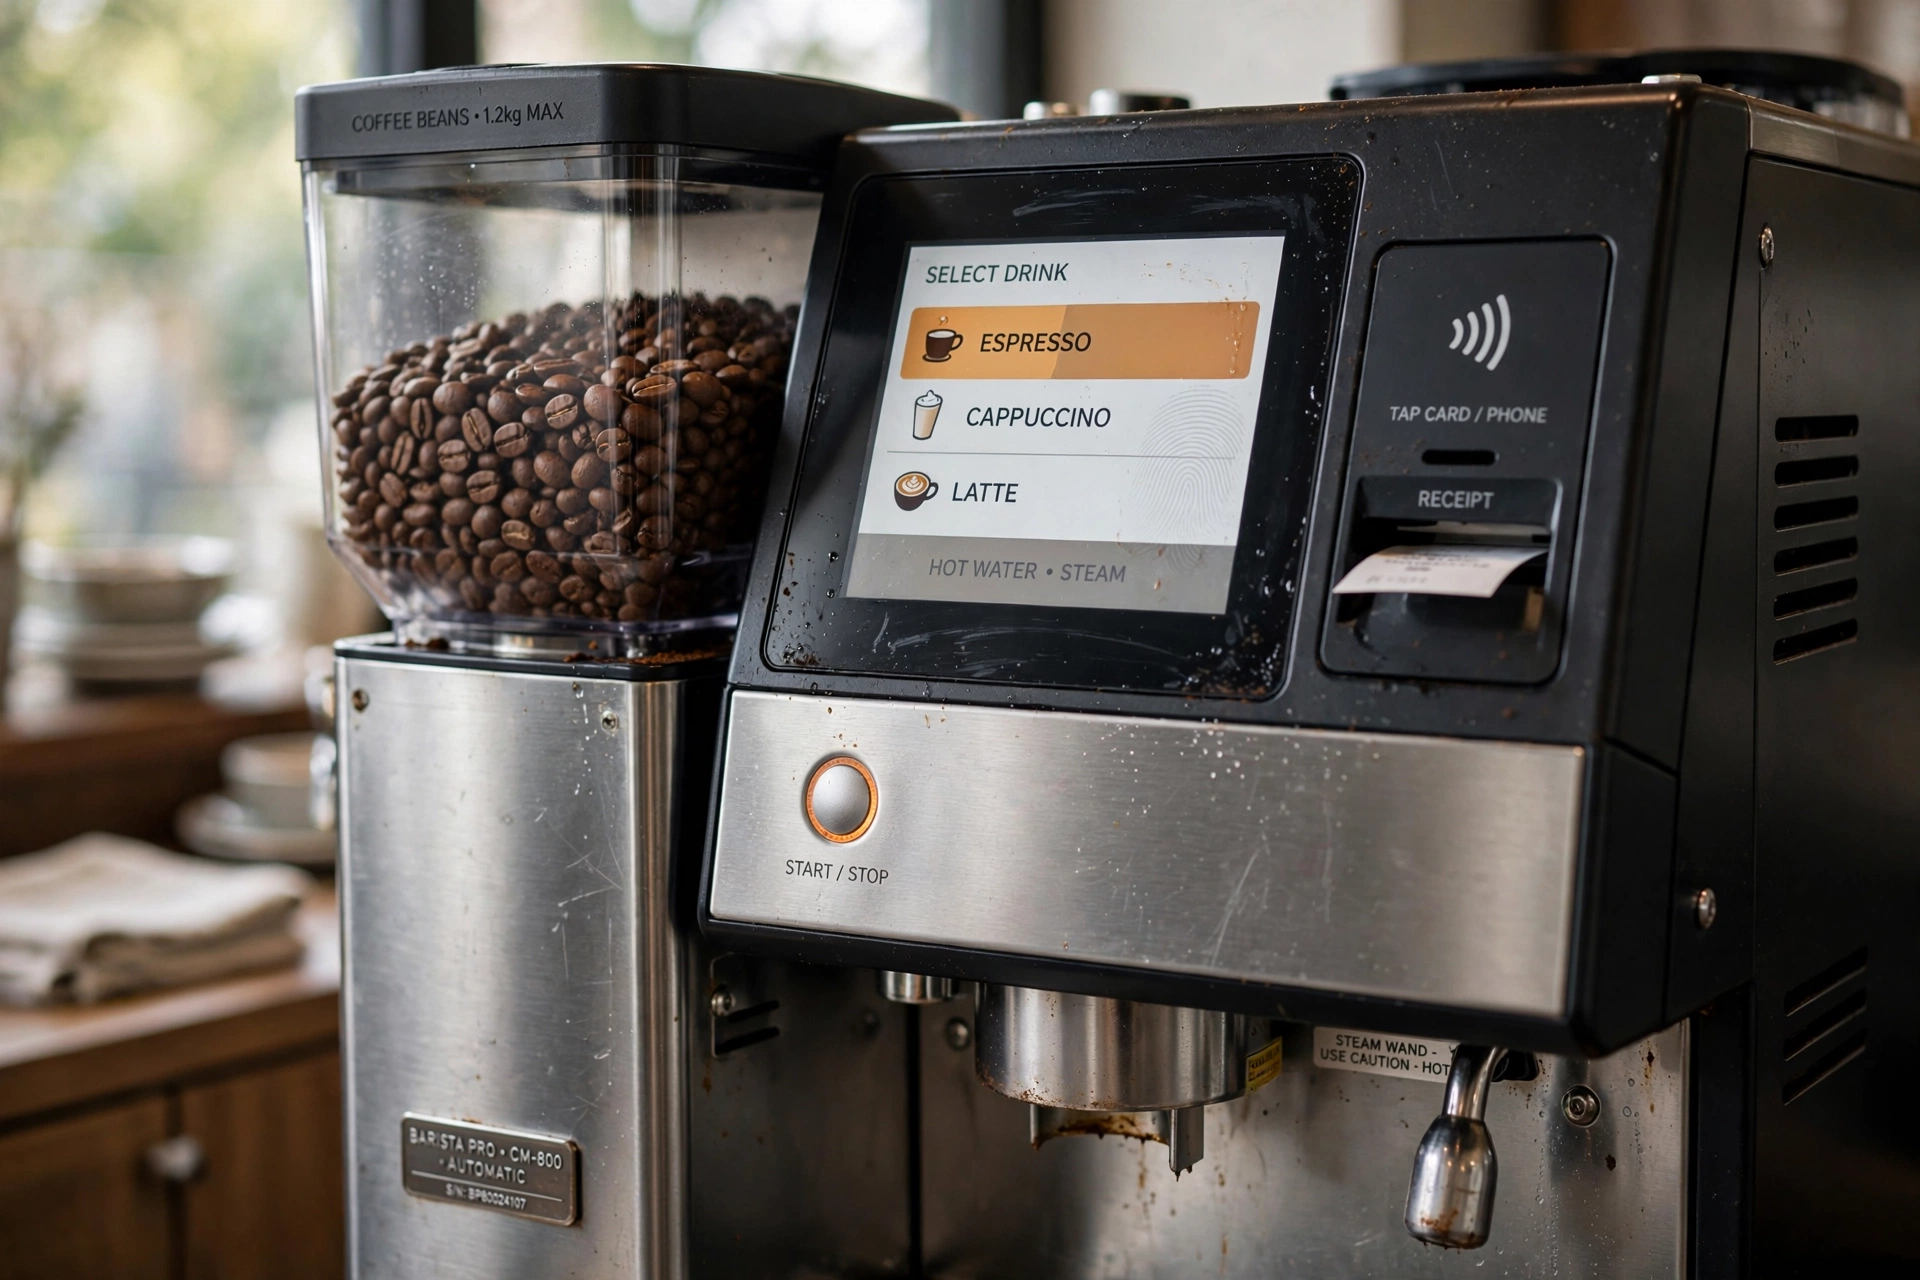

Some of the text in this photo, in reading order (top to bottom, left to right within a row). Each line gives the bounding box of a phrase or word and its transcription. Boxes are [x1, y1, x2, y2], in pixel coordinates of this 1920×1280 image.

[352, 111, 412, 133] COFFEE
[417, 108, 470, 129] BEANS
[483, 105, 522, 127] 1.2kg
[526, 101, 564, 122] MAX
[925, 262, 1069, 284] SELECT DRINK
[980, 331, 1092, 352] ESPRESSO
[966, 407, 1111, 428] CAPPUCCINO
[1389, 406, 1421, 422] TAP
[1424, 406, 1471, 422] CARD
[1486, 406, 1548, 424] PHONE
[951, 482, 1019, 503] LATTE
[1418, 490, 1495, 509] RECEIPT
[928, 558, 969, 577] HOT
[973, 560, 1037, 580] WATER
[1059, 563, 1127, 583] STEAM
[785, 859, 833, 880] START
[848, 865, 889, 885] STOP
[1335, 1033, 1381, 1051] STEAM
[1385, 1039, 1428, 1057] WAND
[1320, 1048, 1346, 1063] USE
[1350, 1051, 1410, 1071] CAUTION
[1422, 1060, 1450, 1076] HOT
[409, 1127, 464, 1152] BARISTA
[468, 1138, 495, 1157] PRO
[509, 1146, 563, 1170] CM-800
[446, 1156, 526, 1184] AUTOMATIC
